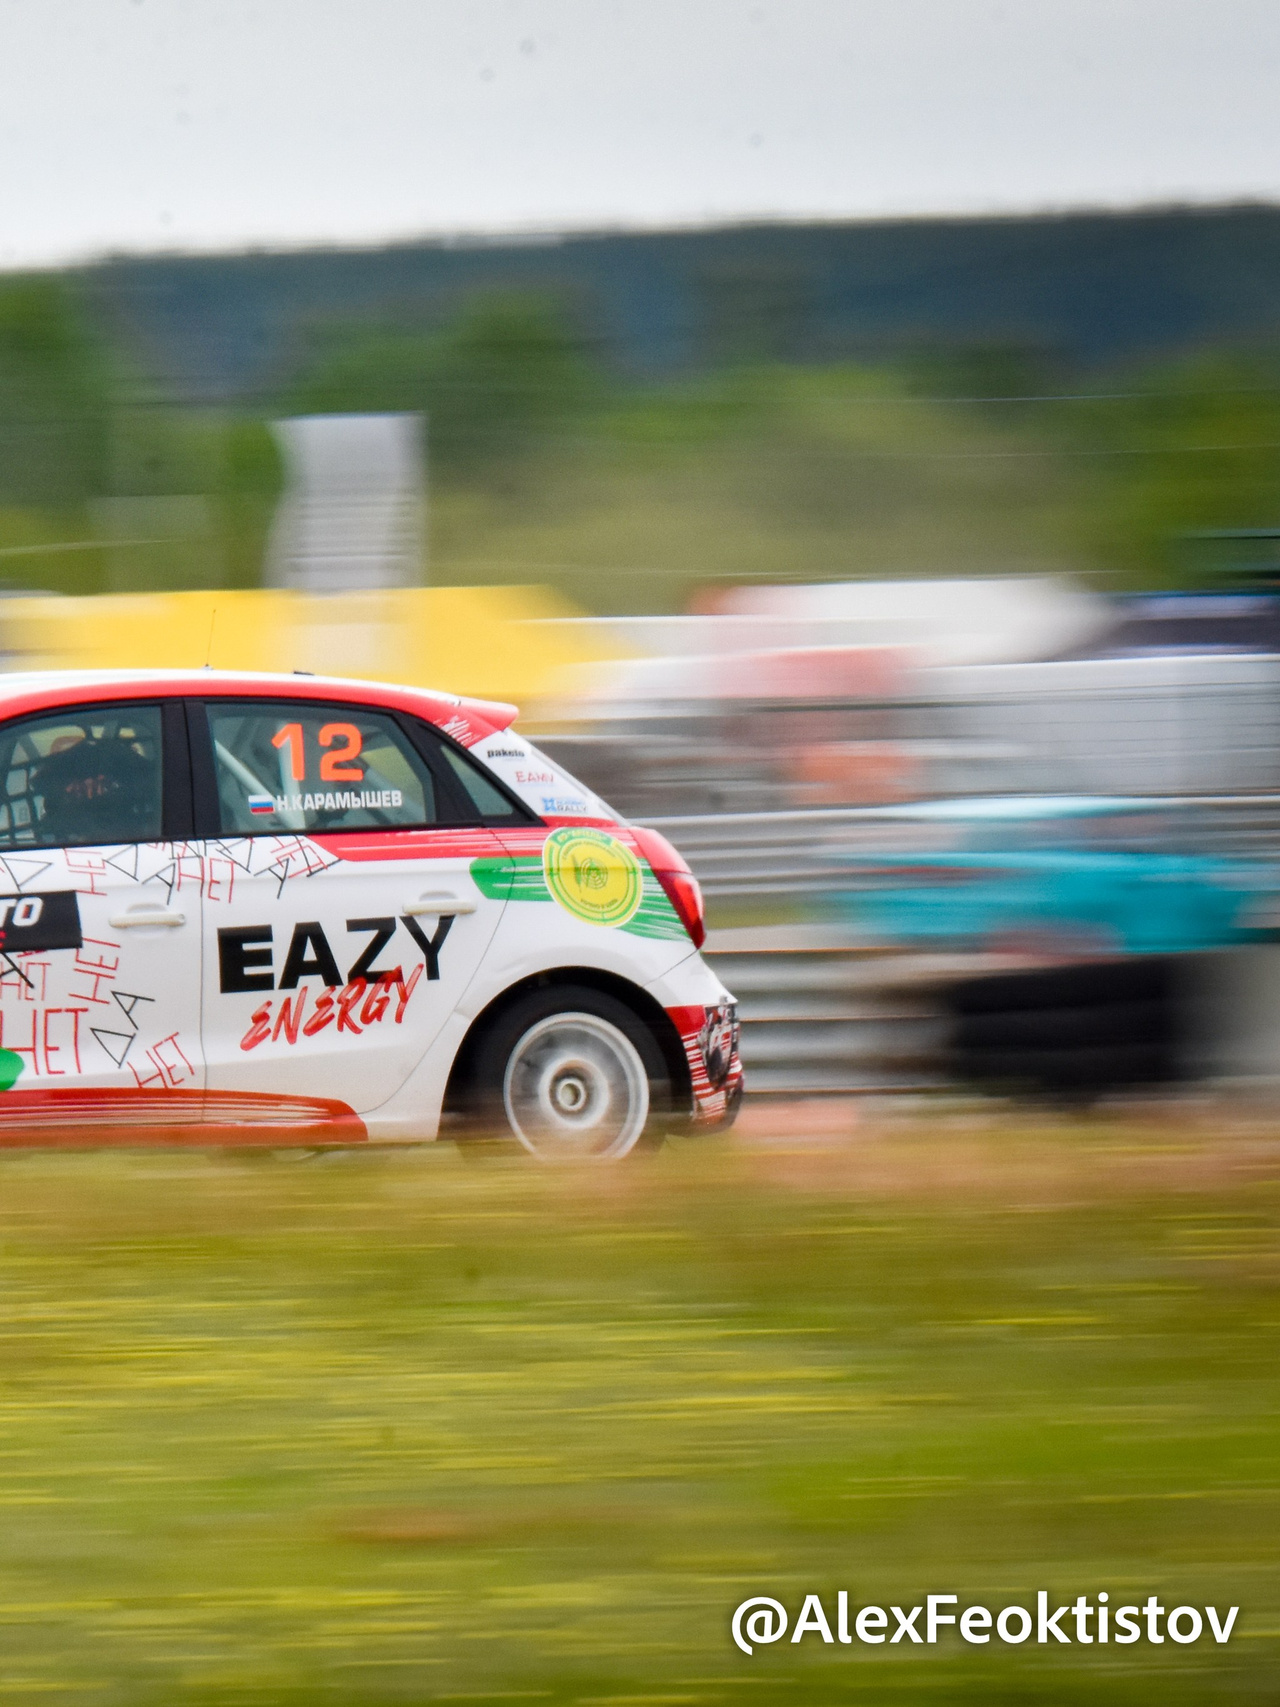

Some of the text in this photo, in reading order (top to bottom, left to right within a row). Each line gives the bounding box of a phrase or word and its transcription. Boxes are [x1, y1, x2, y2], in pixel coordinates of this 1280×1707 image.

[271, 722, 364, 782] 12
[276, 790, 403, 811] Н.КАРАМЫШЕВ
[217, 914, 457, 994] EAZY
[239, 963, 424, 1052] ENERGY
[126, 1031, 196, 1089] НЕТ
